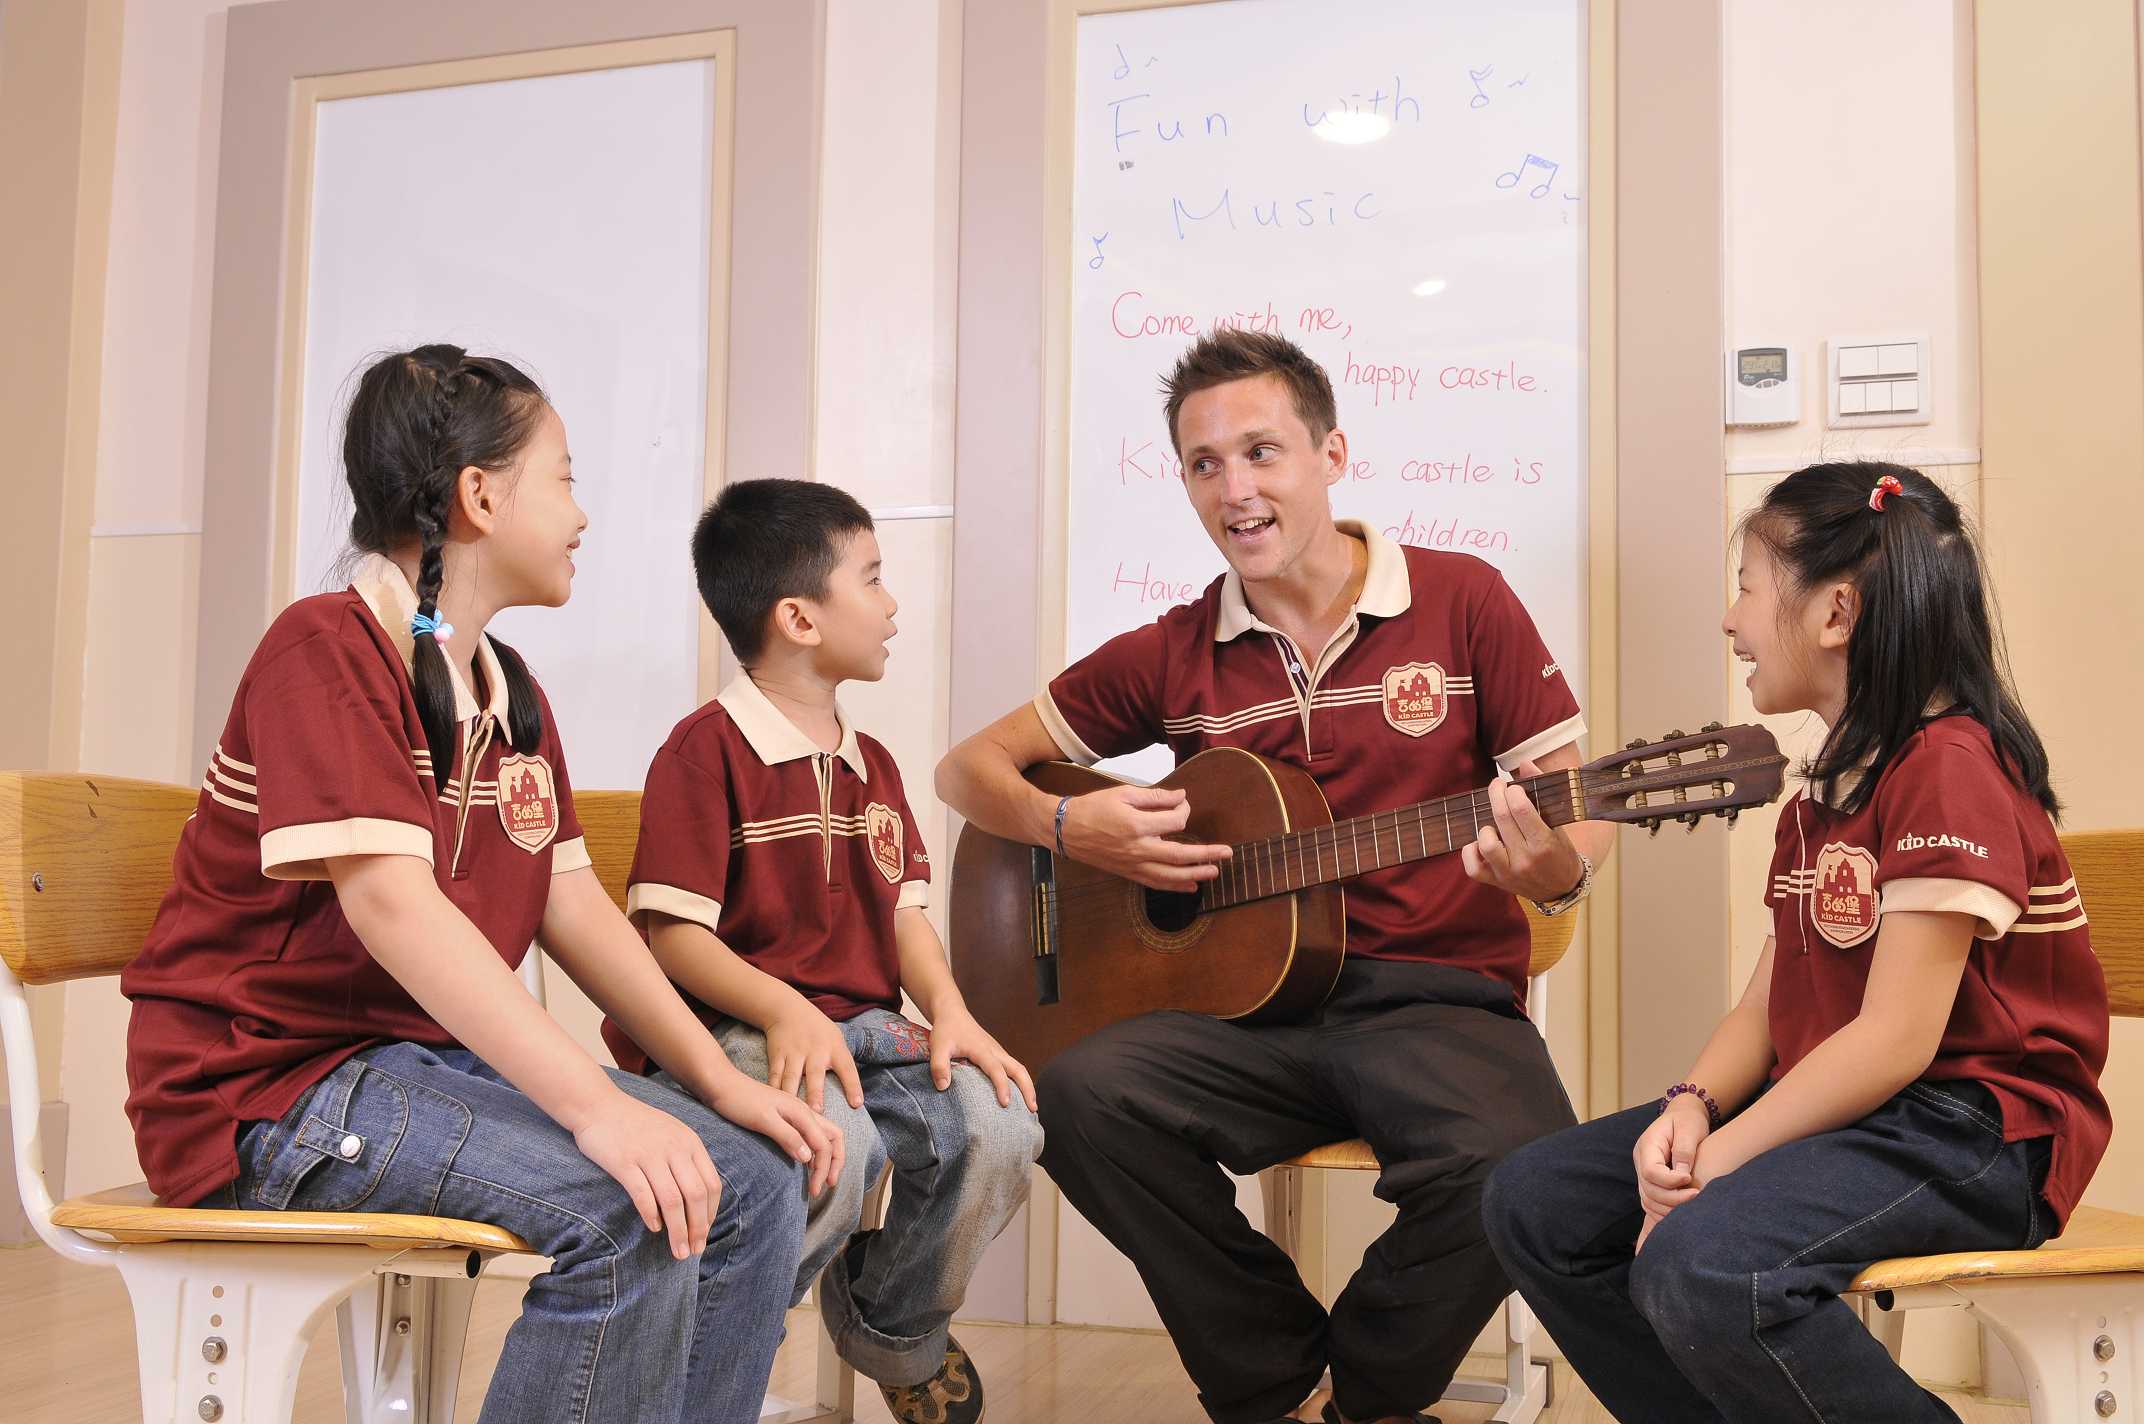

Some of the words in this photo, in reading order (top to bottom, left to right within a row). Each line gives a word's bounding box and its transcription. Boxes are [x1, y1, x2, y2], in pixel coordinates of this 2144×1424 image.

[1108, 94, 1229, 152] Fun
[1172, 189, 1383, 240] Music
[1112, 291, 1200, 338] Come
[1299, 305, 1352, 340] me,
[1345, 351, 1421, 406] happy
[1440, 361, 1548, 392] castle.
[1401, 453, 1494, 484] castle
[1514, 457, 1543, 484] is
[1114, 561, 1202, 603] Have
[1897, 832, 1925, 851] KID
[1927, 833, 1989, 859] CASTLE
[1833, 914, 1862, 924] CASTLE
